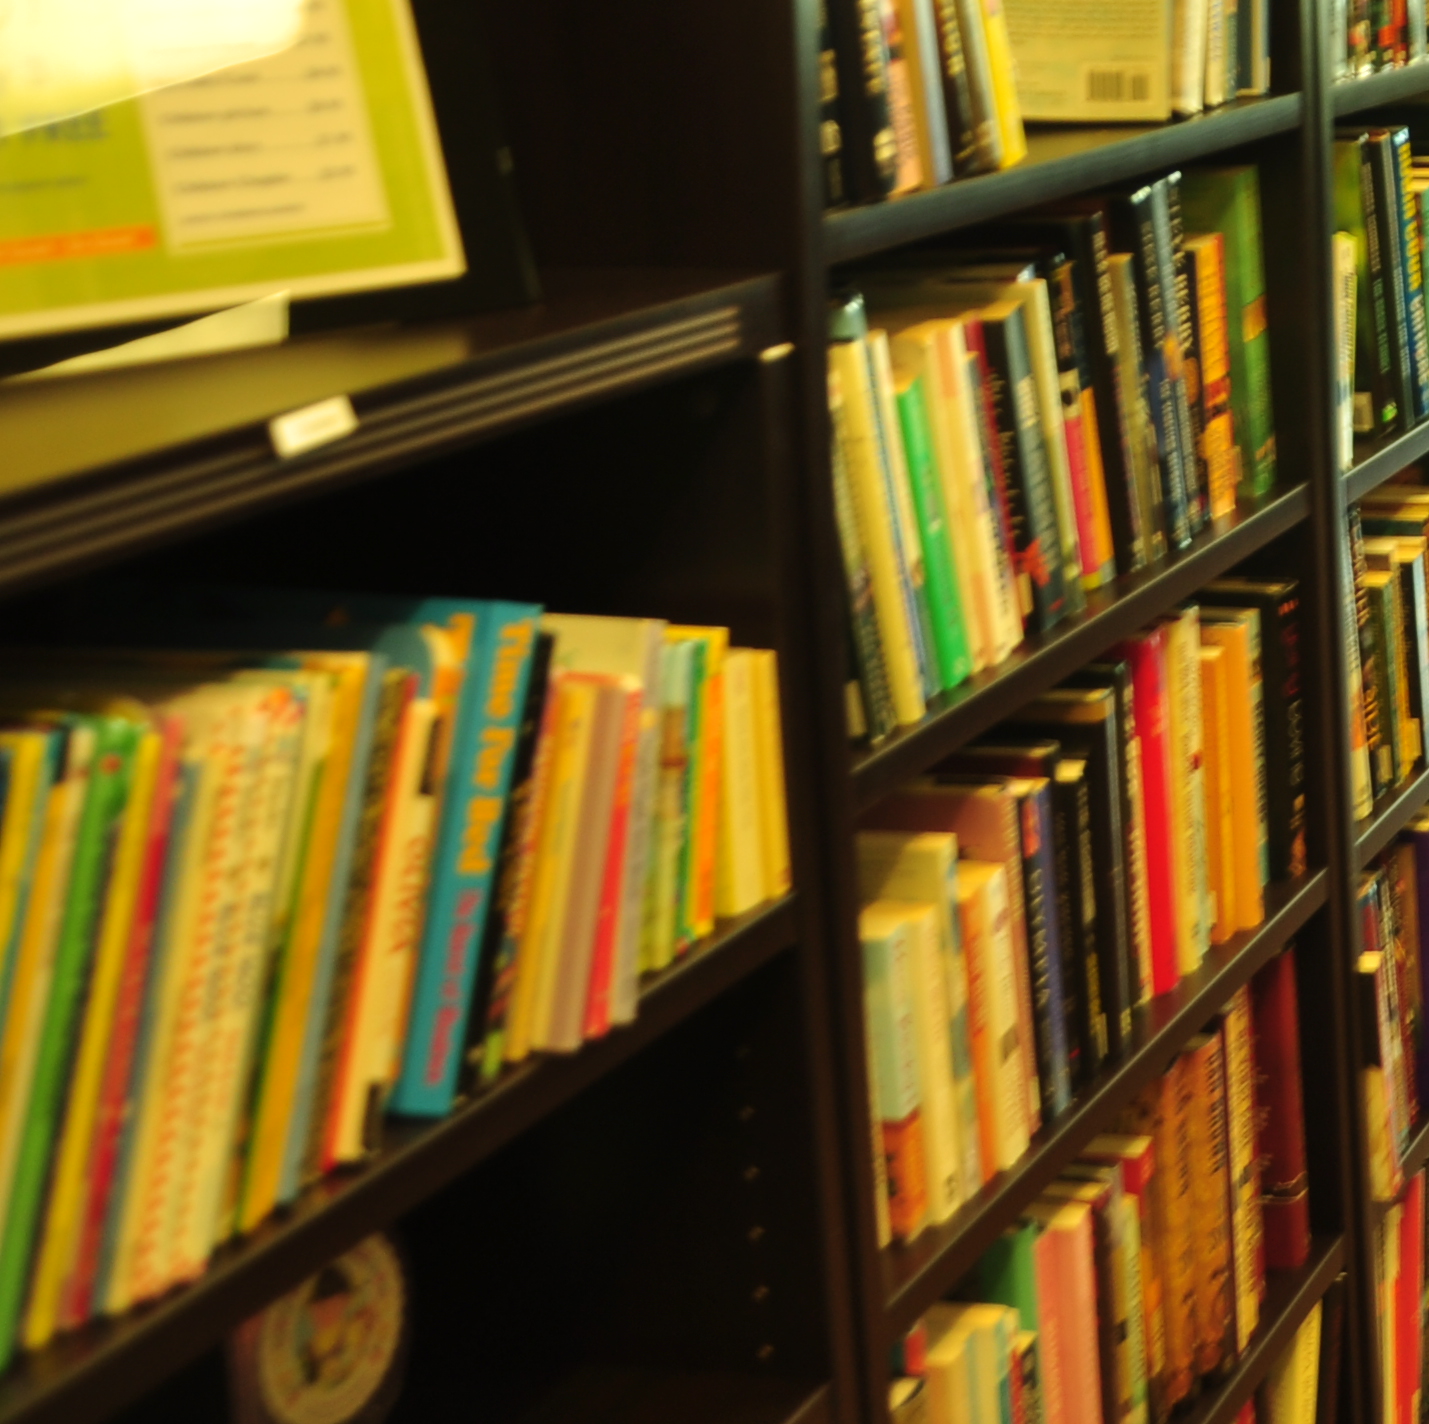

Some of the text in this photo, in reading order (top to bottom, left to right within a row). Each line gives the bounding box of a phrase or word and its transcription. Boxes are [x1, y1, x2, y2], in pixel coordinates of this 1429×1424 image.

[455, 619, 533, 874] Time For Bed
